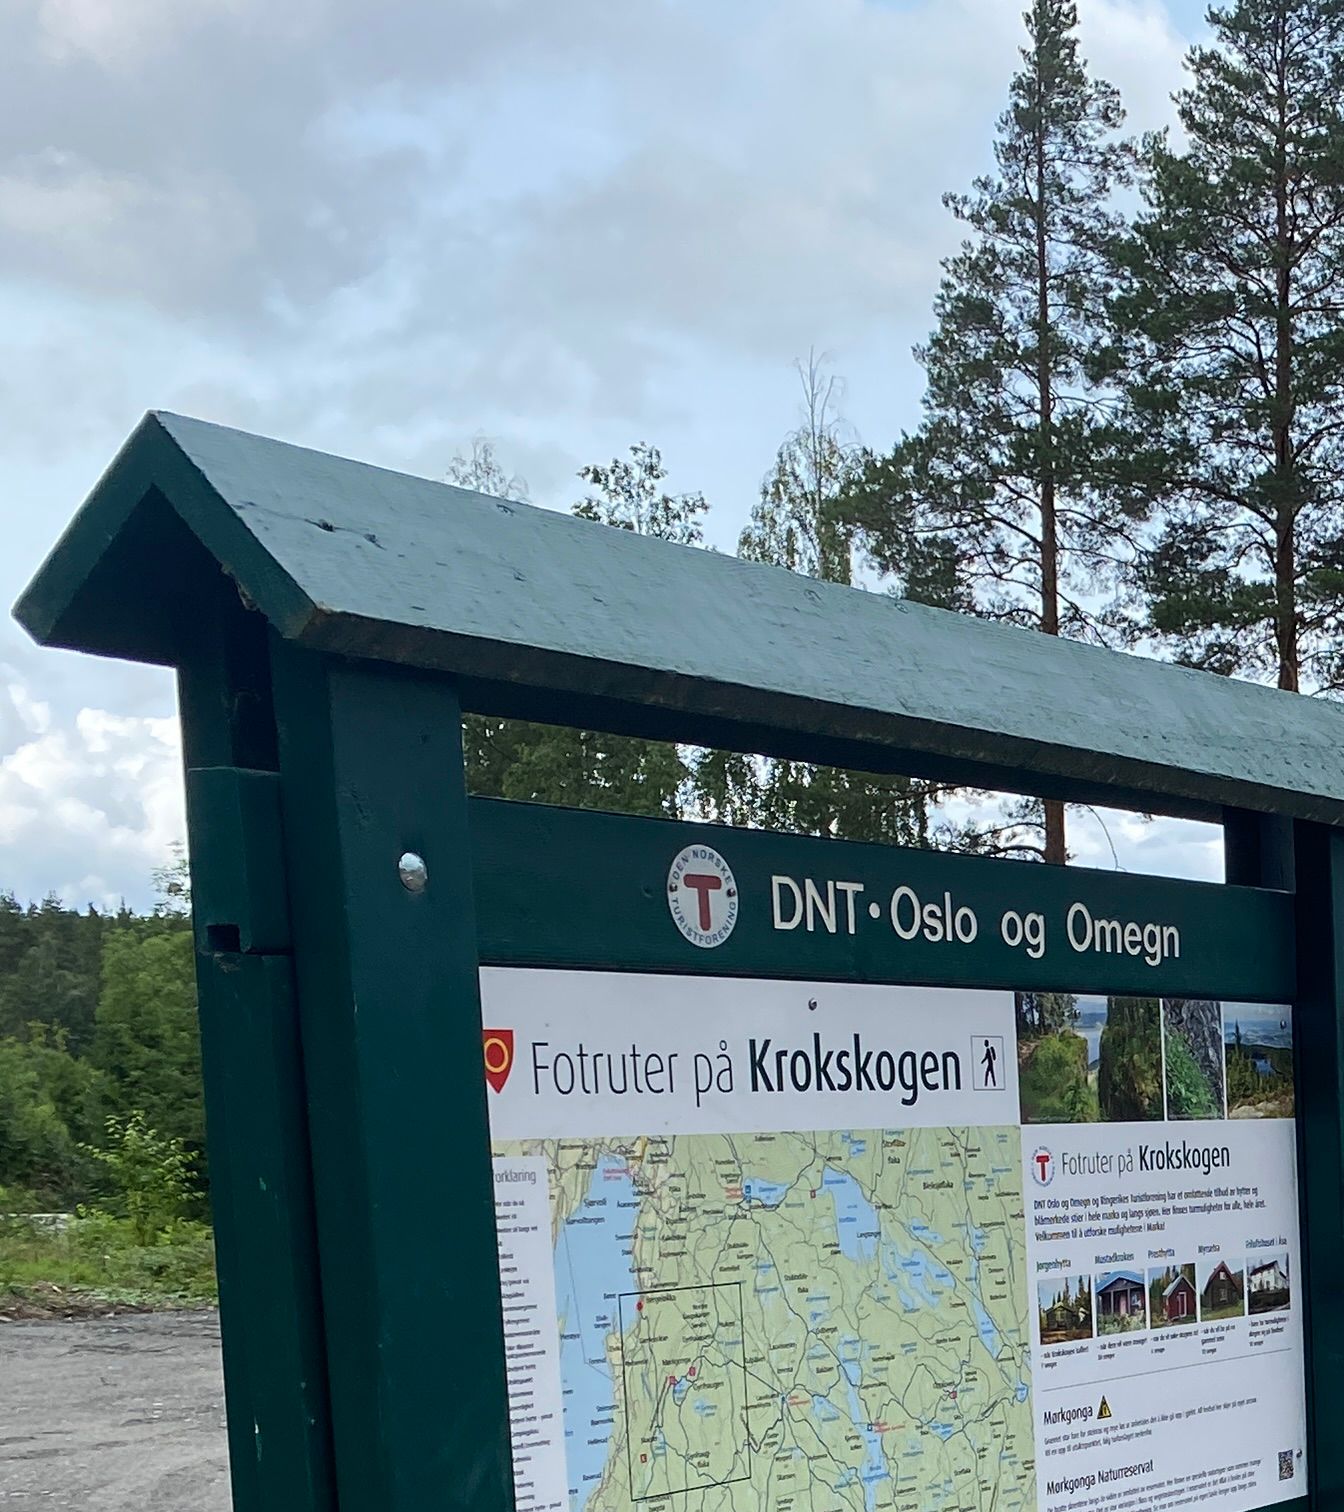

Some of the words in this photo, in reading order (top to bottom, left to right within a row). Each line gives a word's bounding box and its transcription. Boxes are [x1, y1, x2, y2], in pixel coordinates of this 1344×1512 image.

[672, 855, 689, 880] DEN
[692, 849, 732, 884] NORSKE
[683, 873, 722, 931] T
[672, 897, 736, 945] TURISTFORENING
[890, 885, 979, 943] Oslo
[1001, 909, 1045, 959] og
[1066, 901, 1181, 967] Omegn
[532, 1041, 679, 1095] Fotruter
[693, 1039, 734, 1107] på
[749, 1033, 961, 1106] Krokskogen
[495, 1169, 536, 1184] orklaring
[1061, 1151, 1114, 1177] Fotruter
[1117, 1148, 1134, 1179] på
[1139, 1140, 1231, 1175] Krokskogen
[1033, 1199, 1045, 1209] DNT
[1046, 1198, 1059, 1208] Oslo
[1060, 1197, 1069, 1210] og
[1069, 1198, 1090, 1208] Omegn
[1091, 1197, 1099, 1207] og
[1087, 1211, 1100, 1221] hele
[1128, 1209, 1143, 1219] langs
[1035, 1231, 1070, 1240] Velkommen
[1043, 1406, 1092, 1424] Mørkgonga
[1046, 1475, 1095, 1494] Mørkgonga
[1097, 1460, 1152, 1482] Naturreservat
